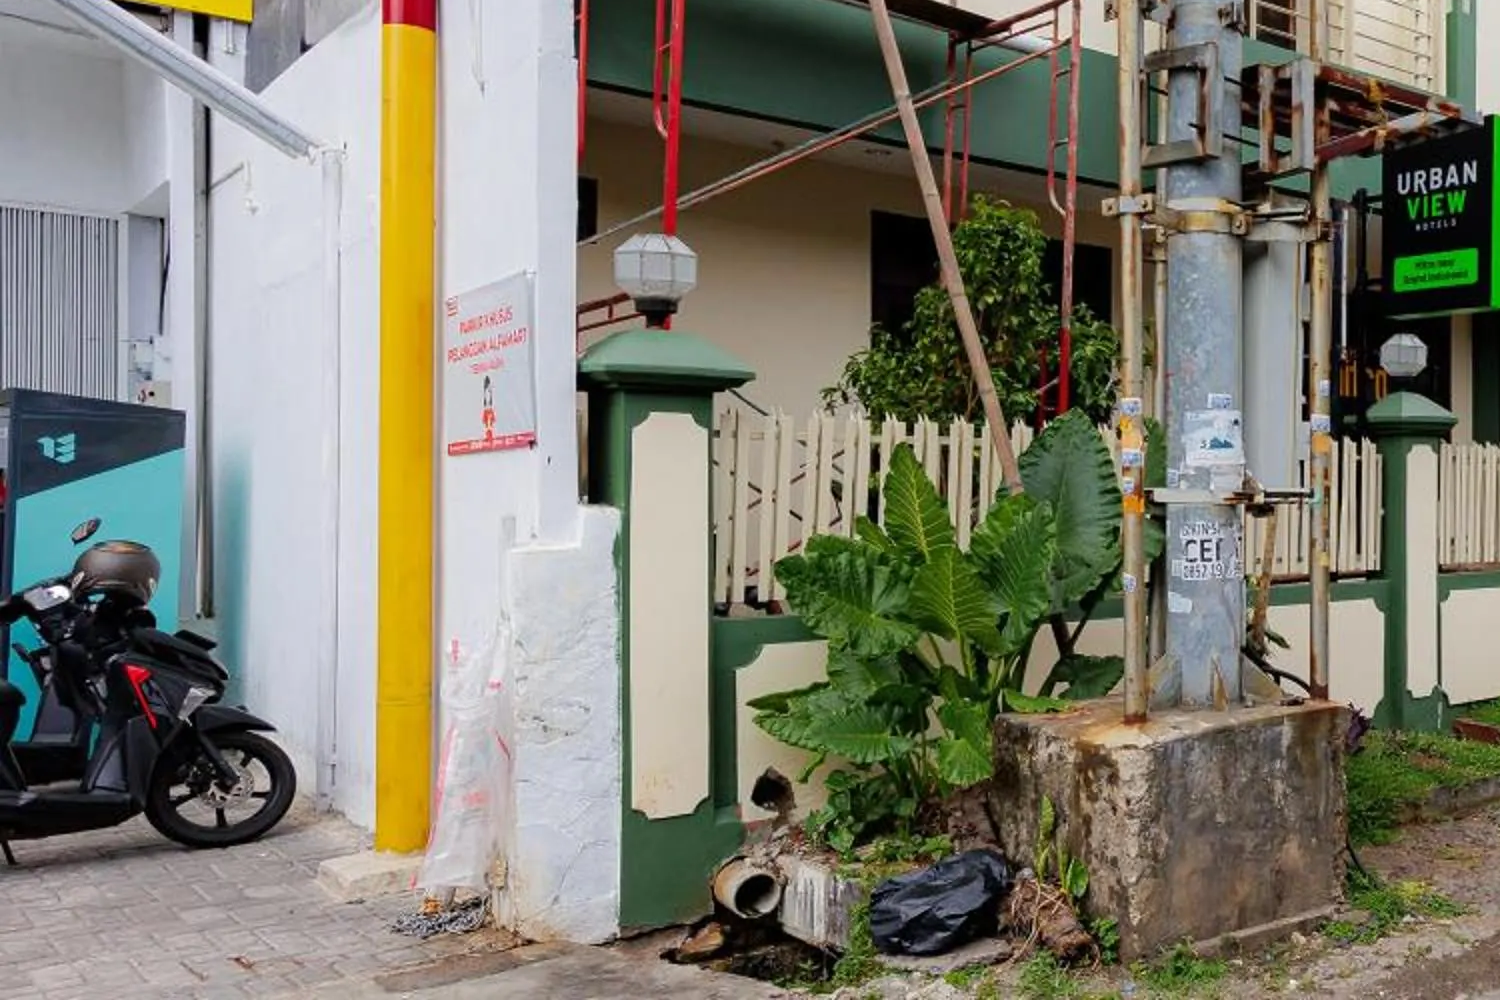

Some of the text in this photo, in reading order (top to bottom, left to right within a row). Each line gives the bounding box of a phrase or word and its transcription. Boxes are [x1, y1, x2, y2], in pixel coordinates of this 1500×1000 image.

[1397, 160, 1477, 196] URBAN
[1407, 189, 1467, 220] VIEW
[1415, 218, 1457, 232] HOTELS
